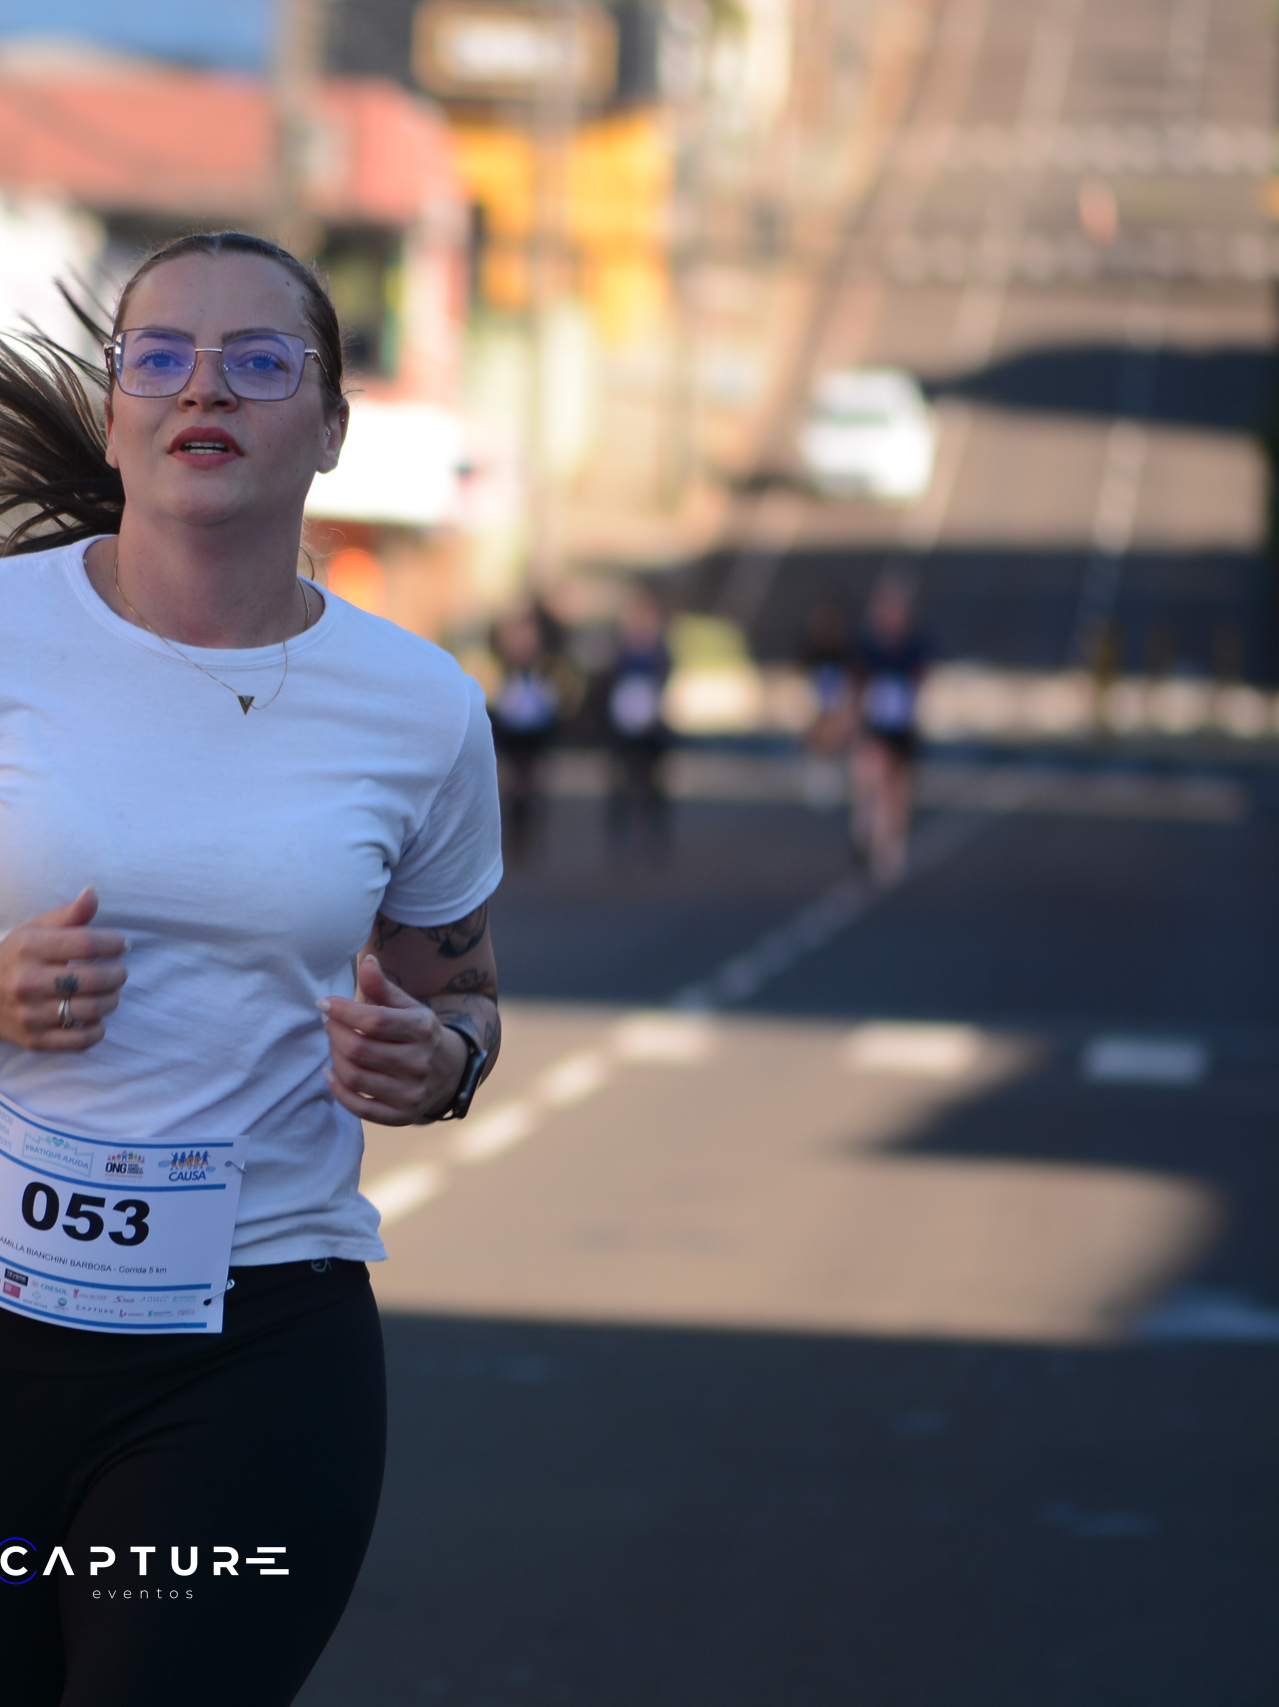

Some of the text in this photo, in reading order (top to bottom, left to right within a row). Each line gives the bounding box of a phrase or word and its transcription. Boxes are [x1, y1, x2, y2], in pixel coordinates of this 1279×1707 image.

[25, 1144, 89, 1170] PRATIQUE AJUDA
[105, 1162, 127, 1174] ONG
[168, 1170, 207, 1182] CAUSA
[21, 1181, 150, 1246] 053
[26, 1247, 68, 1265] BIANCHINI
[70, 1258, 112, 1273] BARBOSA
[118, 1266, 147, 1274] Corrida
[148, 1266, 154, 1274] 5
[156, 1266, 167, 1274] km
[40, 1283, 68, 1295] CRESOL
[76, 1304, 115, 1315] CAPTURE
